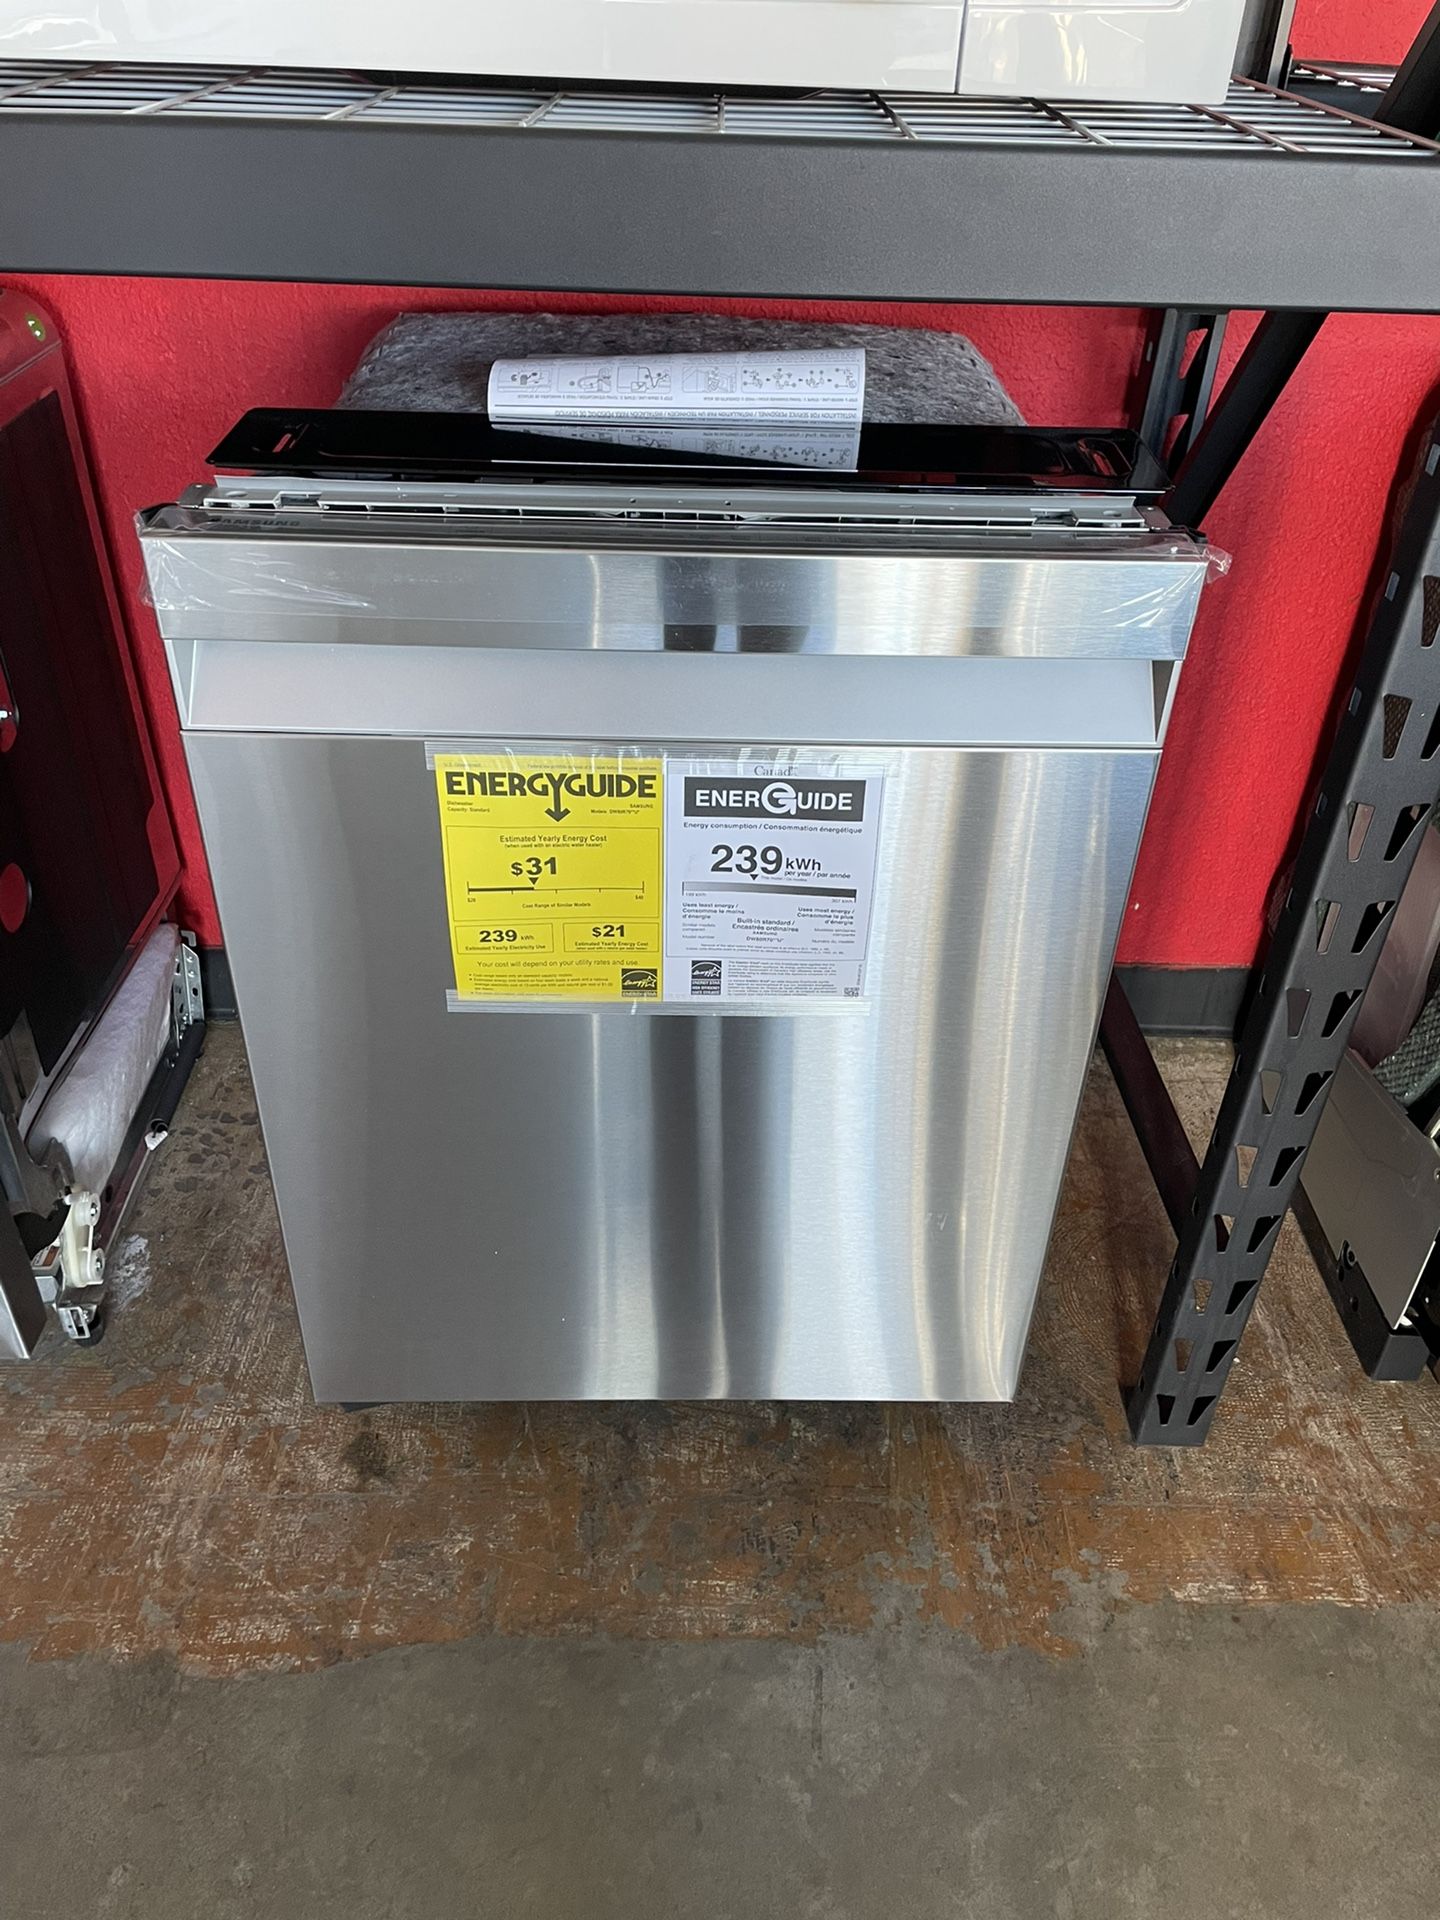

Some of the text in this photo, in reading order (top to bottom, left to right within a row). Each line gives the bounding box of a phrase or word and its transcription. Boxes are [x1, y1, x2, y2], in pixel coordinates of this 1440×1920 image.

[757, 410, 788, 418] PERSONNEL
[445, 771, 657, 800] ENERGYGUIDE
[695, 781, 853, 816] ENERGUIDE
[683, 822, 709, 831] Energy
[710, 822, 758, 831] consumption
[763, 823, 818, 833] Consommation
[819, 825, 863, 834] énergétique
[499, 834, 608, 843] Estimated Yearly Energy Cost
[511, 856, 558, 877] $31
[710, 844, 783, 875] 239
[785, 857, 822, 871] kWh
[816, 871, 829, 879] par
[479, 929, 518, 943] 239
[592, 924, 625, 938] $21
[522, 960, 548, 968] depend
